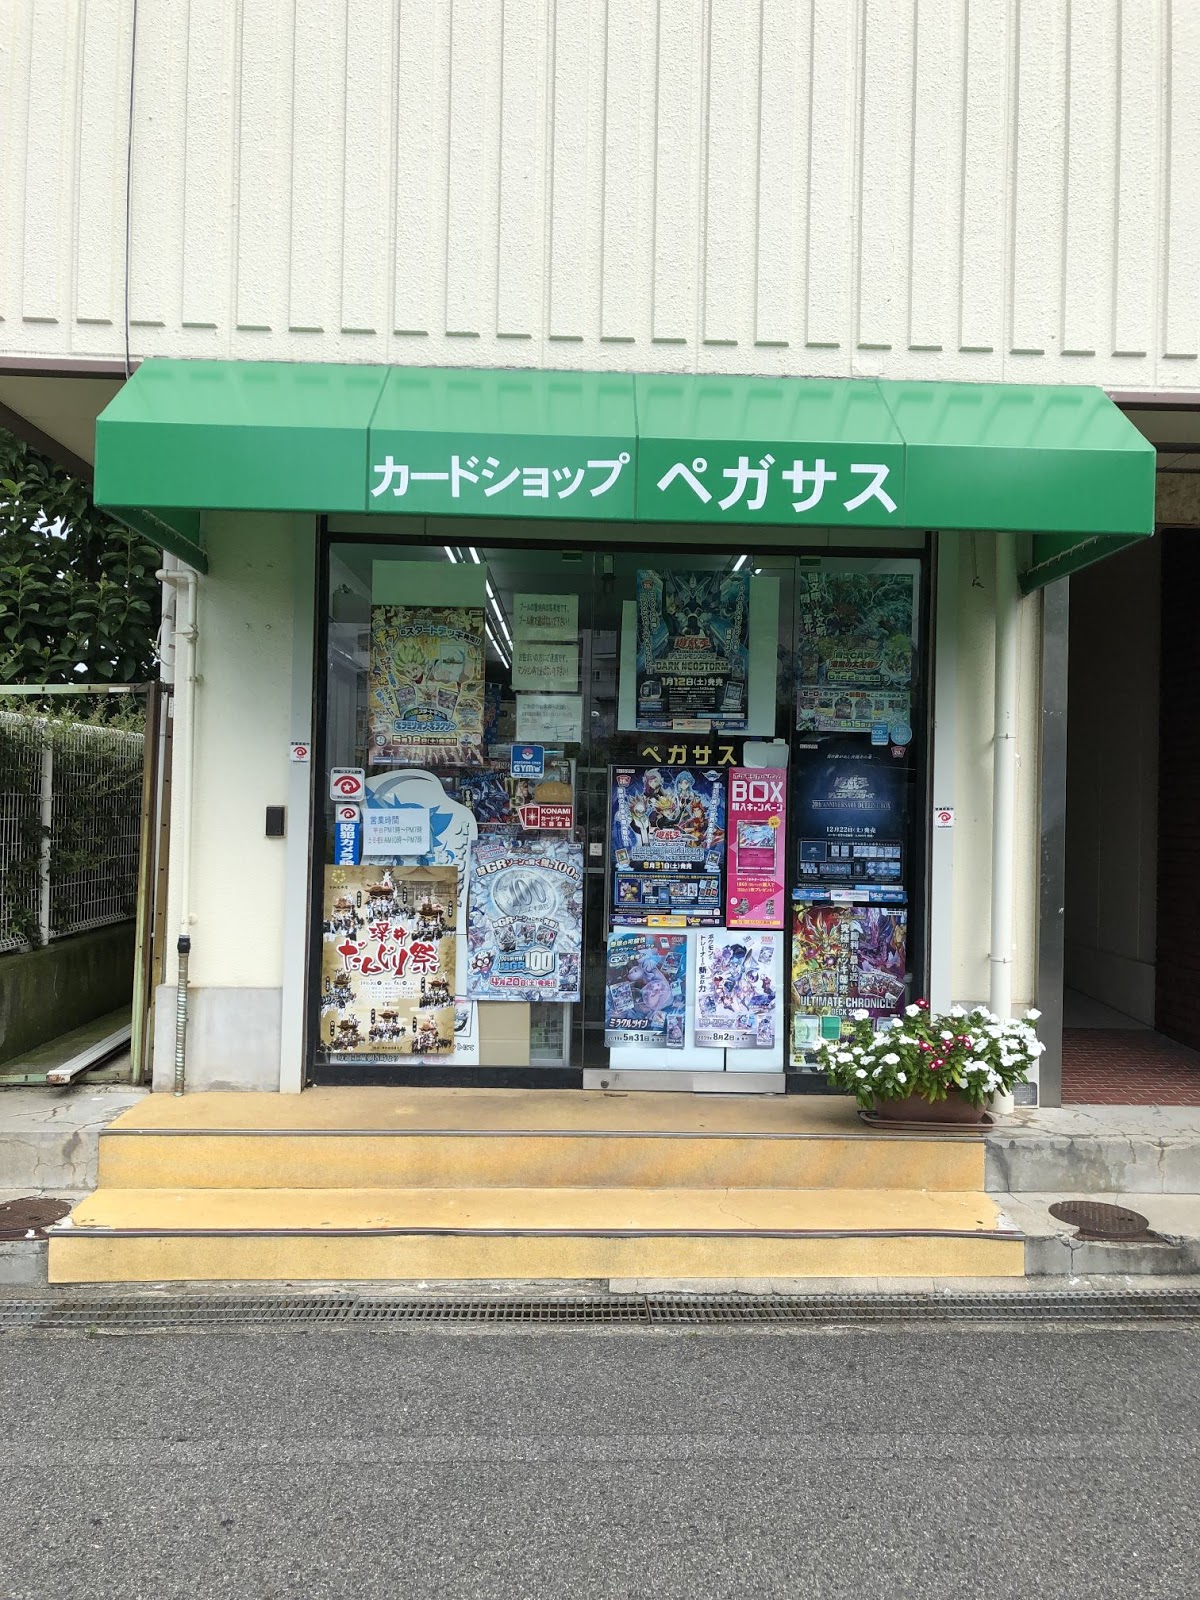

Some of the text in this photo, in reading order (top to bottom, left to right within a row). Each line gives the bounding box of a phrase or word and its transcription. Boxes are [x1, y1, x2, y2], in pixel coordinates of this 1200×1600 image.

[371, 452, 897, 513] カードショップ ペガサス
[674, 637, 711, 650] 遊戯王
[656, 661, 729, 670] DARK NEOSTORM
[661, 677, 723, 687] 1月12日(土)発売
[642, 744, 737, 765] ペガサス
[513, 764, 534, 773] GYM
[732, 781, 784, 802] BOX
[732, 803, 783, 811] 購入キャンペーン
[370, 816, 400, 825] 営業時間
[826, 826, 876, 834] 12月22日(土)発売
[337, 940, 439, 976] だんじり祭
[490, 977, 557, 988] 4月20日(土)発売!!
[801, 996, 896, 1009] ULTIMATE CHRONICLE
[831, 1008, 847, 1016] DECK
[609, 1018, 648, 1029] ミラクルツイン
